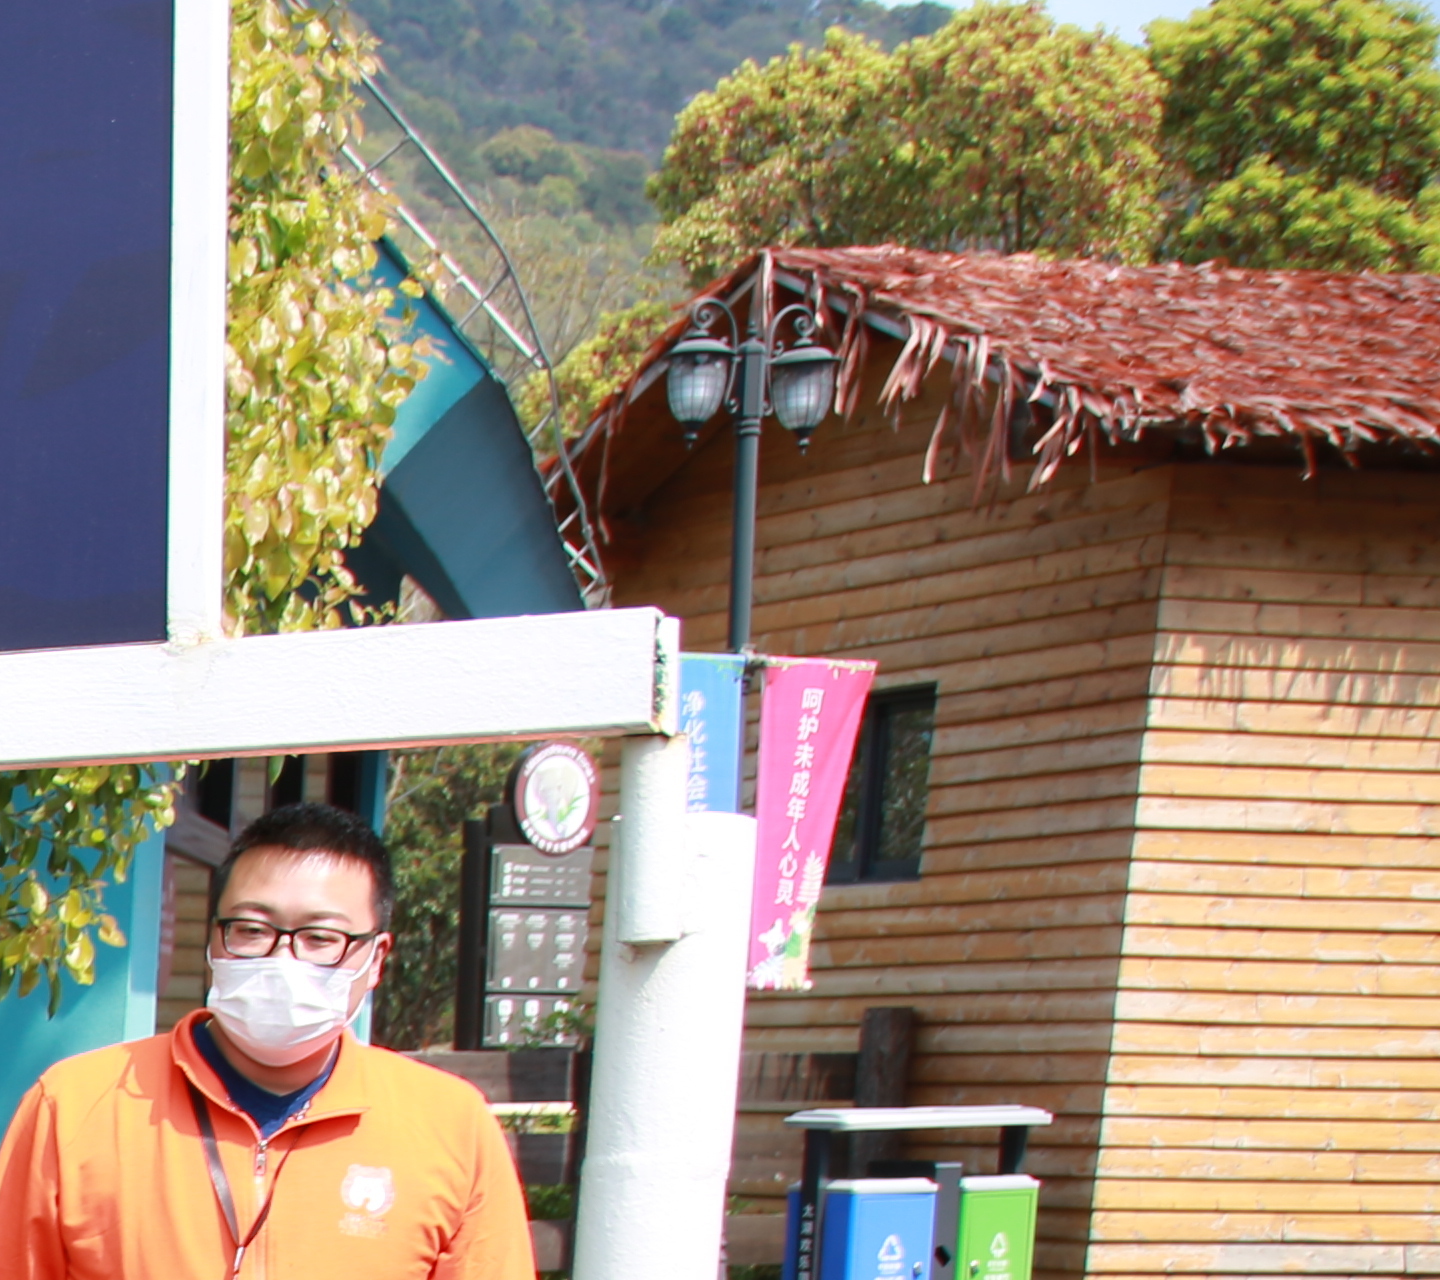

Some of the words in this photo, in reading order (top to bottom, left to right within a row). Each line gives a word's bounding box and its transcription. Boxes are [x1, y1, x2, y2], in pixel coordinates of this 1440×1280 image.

[774, 688, 824, 906] 呵护未成年人心灵
